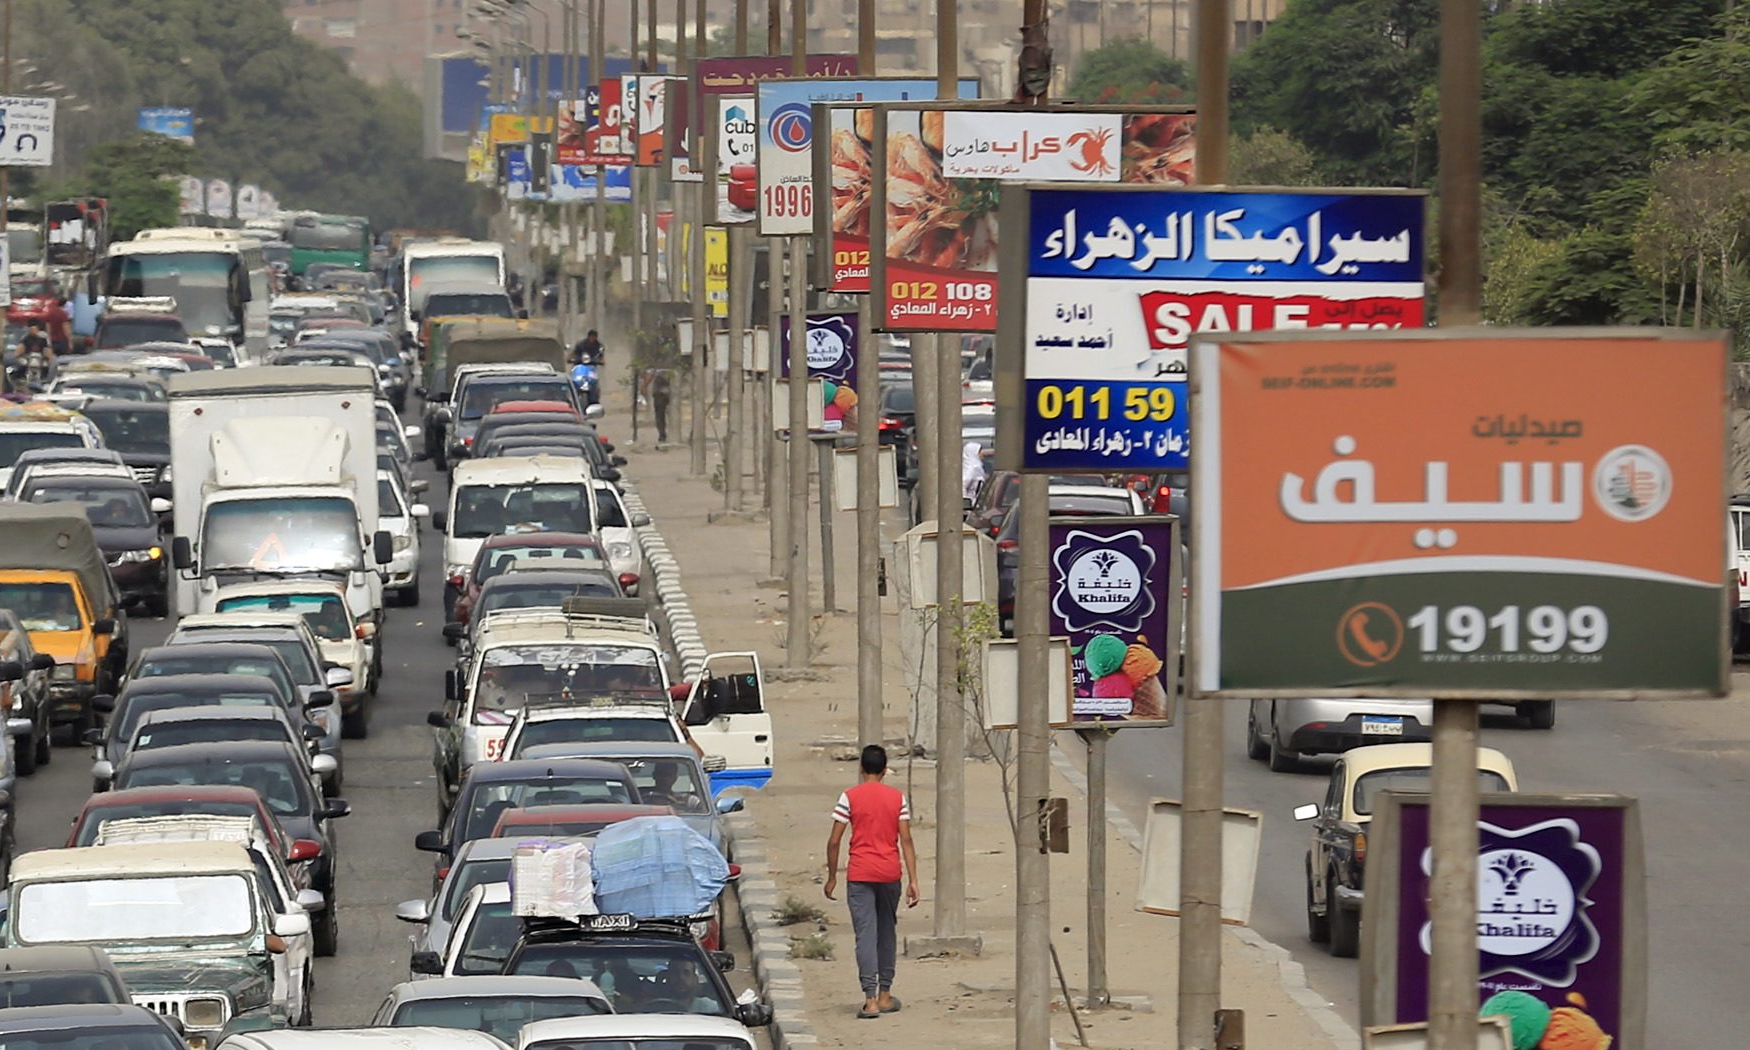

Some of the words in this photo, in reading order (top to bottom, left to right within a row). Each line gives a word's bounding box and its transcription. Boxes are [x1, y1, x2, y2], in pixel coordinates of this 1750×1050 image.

[1041, 208, 1193, 272] الزهراء
[1205, 208, 1410, 275] سيراميكا
[835, 267, 869, 282] لمعادي
[891, 282, 937, 299] 012
[946, 282, 992, 300] 108
[1037, 386, 1110, 420] 011
[1124, 387, 1175, 421] 59
[1472, 414, 1583, 444] صيدليات
[1280, 435, 1584, 549] سيف
[1078, 594, 1131, 603] Khalifa
[1407, 605, 1609, 653] 19199
[1478, 898, 1558, 920] خليف
